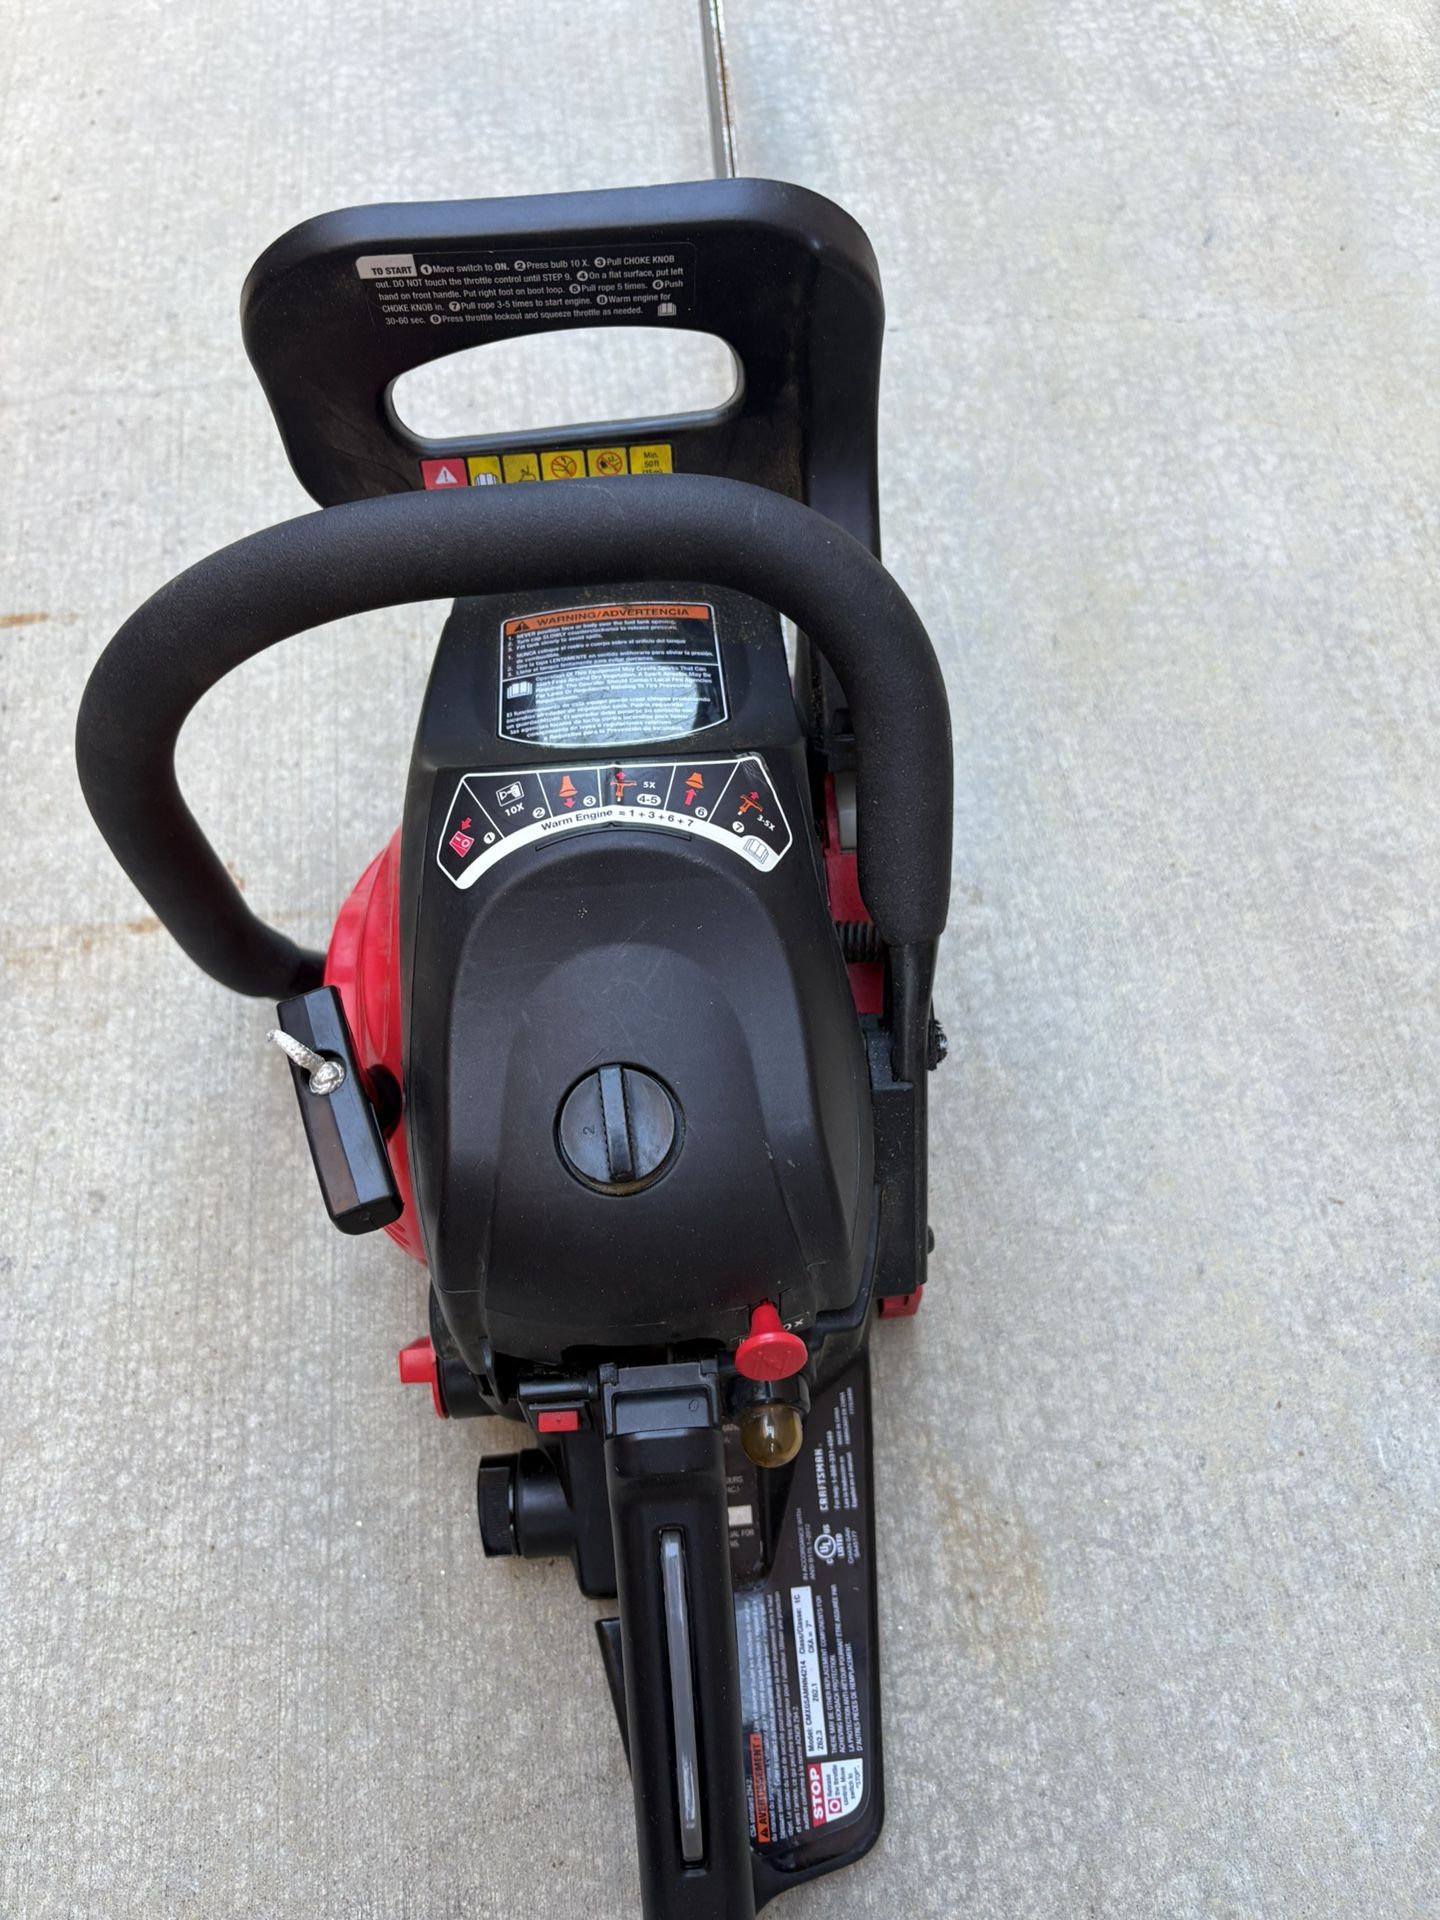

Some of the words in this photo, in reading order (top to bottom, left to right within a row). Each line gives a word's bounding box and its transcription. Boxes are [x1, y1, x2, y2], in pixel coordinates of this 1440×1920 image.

[371, 267, 382, 275] TO
[384, 266, 412, 274] START
[432, 264, 454, 273] Move
[456, 263, 482, 272] switch
[484, 263, 493, 271] to
[494, 262, 509, 270] ON.
[526, 260, 548, 269] Press
[550, 259, 567, 268] bulb
[570, 259, 580, 267] 10
[606, 257, 621, 265] Pull
[623, 256, 650, 264] CHOKE
[652, 254, 674, 263] KNOB
[375, 280, 391, 288] out.
[392, 279, 404, 287] DO
[424, 278, 446, 286] touch
[448, 277, 461, 285] the
[463, 276, 492, 284] throttle
[494, 274, 521, 283] control
[523, 274, 540, 282] until
[542, 273, 562, 281] STEP
[564, 272, 572, 280] 9.
[588, 271, 599, 279] On
[608, 270, 621, 278] flat
[622, 268, 654, 279] surface,
[655, 268, 668, 278] put
[670, 267, 683, 275] left
[378, 292, 399, 301] hand
[412, 291, 431, 299] front
[432, 290, 461, 298] handle.
[463, 289, 477, 297] Put
[478, 288, 496, 298] right
[498, 288, 513, 296] foot
[526, 286, 544, 295] boot
[546, 286, 565, 295] loop.
[581, 284, 596, 292] Pull
[598, 285, 615, 293] rope
[624, 281, 647, 290] times.
[664, 280, 683, 288] Push
[381, 304, 408, 313] CHOKE
[410, 303, 433, 312] KNOB
[434, 303, 444, 311] in.
[460, 301, 475, 310] Pull
[477, 302, 495, 311] rope
[497, 300, 510, 309] 3-5
[512, 299, 533, 308] times
[535, 299, 543, 307] to
[544, 298, 562, 307] start
[564, 297, 592, 307] engine.
[608, 295, 630, 303] Warm
[632, 293, 658, 304] engine
[659, 292, 671, 301] for
[410, 317, 427, 325] sec.
[443, 314, 464, 323] Press
[465, 313, 493, 322] throttle
[495, 312, 522, 321] lockout
[524, 311, 539, 320] and
[540, 311, 571, 321] squeeze
[573, 308, 599, 318] throttle
[612, 306, 643, 316] needed.
[537, 608, 689, 626] WARNING/ADVERTENCIA
[505, 802, 524, 815] 10X
[638, 795, 658, 804] 4-5
[541, 816, 572, 830] Warm
[575, 809, 612, 821] Engine
[667, 814, 674, 822] 6
[756, 814, 775, 831] 3-5X
[814, 1448, 829, 1512] CRAFTSMAN
[819, 1539, 832, 1554] UL
[836, 1533, 845, 1557] LISTED
[794, 1594, 801, 1603] 1C
[807, 1727, 815, 1751] Model:
[753, 1744, 768, 1825] AVERTISSEMENT
[810, 1767, 824, 1819] STOP
